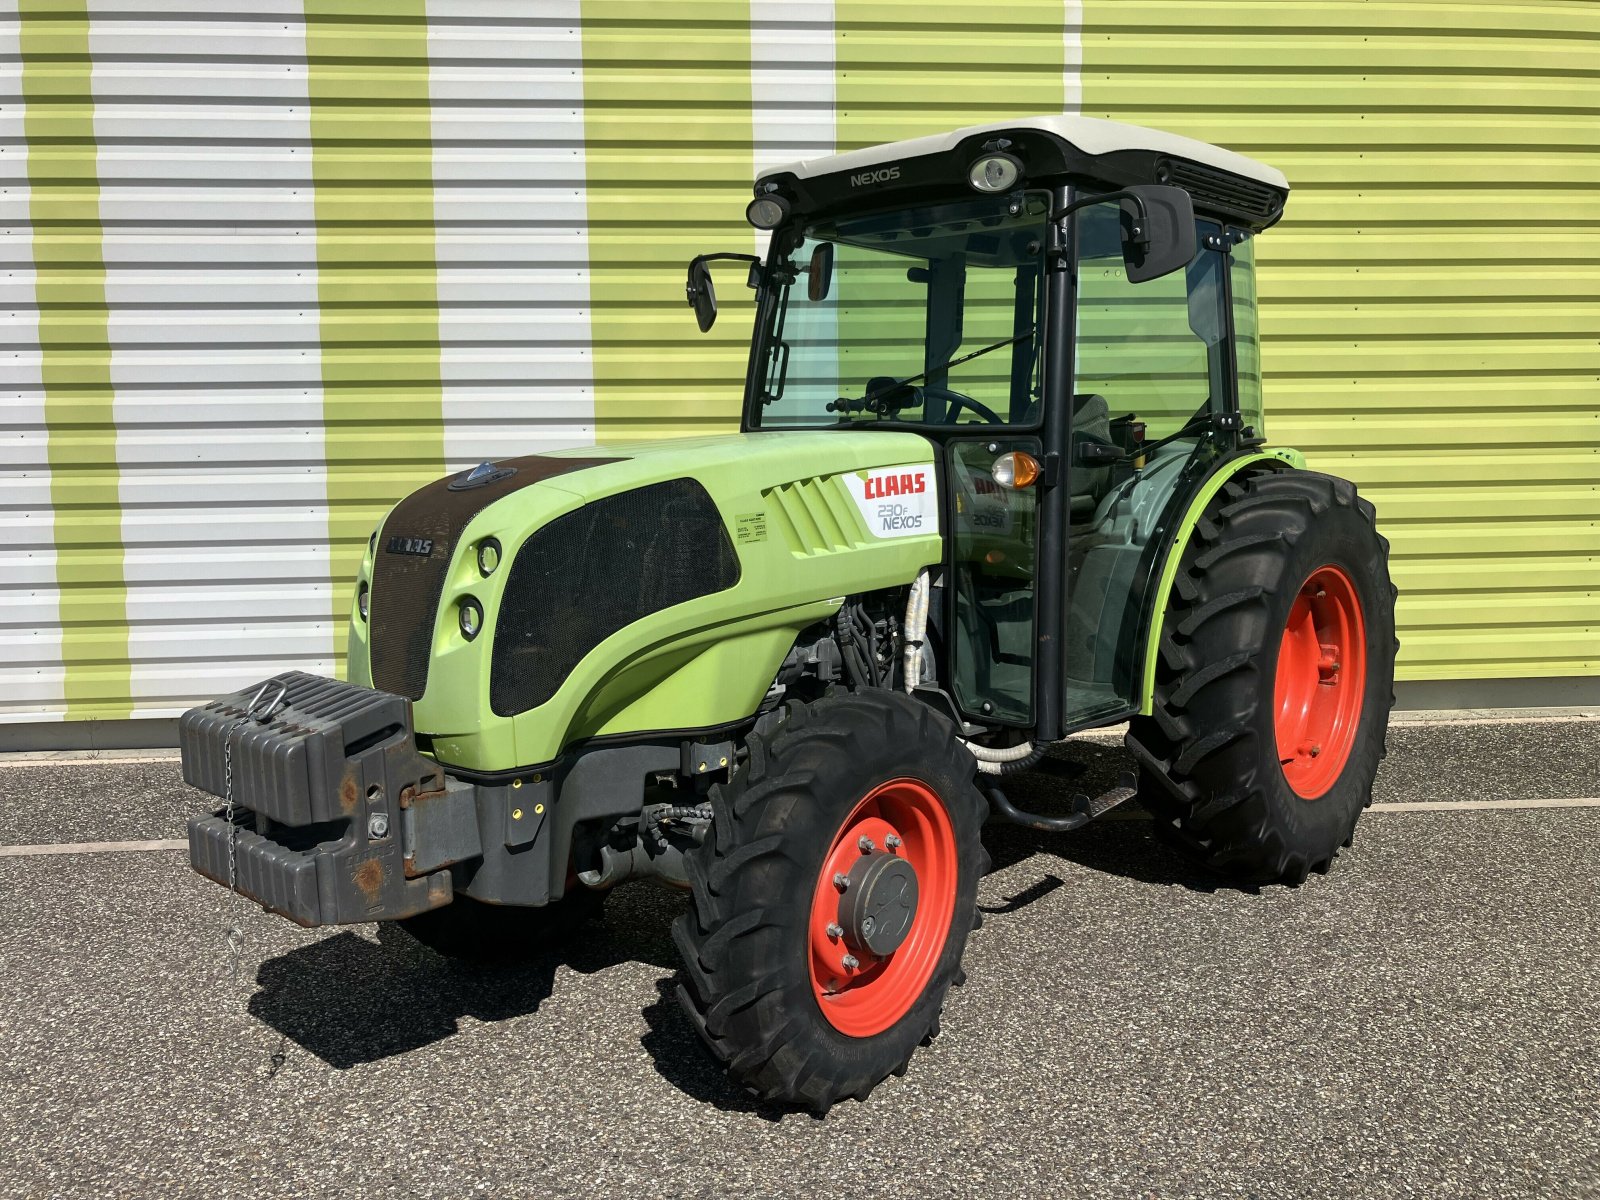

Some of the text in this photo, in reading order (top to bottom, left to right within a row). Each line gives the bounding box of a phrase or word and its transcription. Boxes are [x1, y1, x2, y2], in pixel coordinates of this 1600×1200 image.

[850, 166, 901, 187] NEXOS
[864, 472, 926, 500] CLAAS
[882, 515, 923, 531] NEXOS
